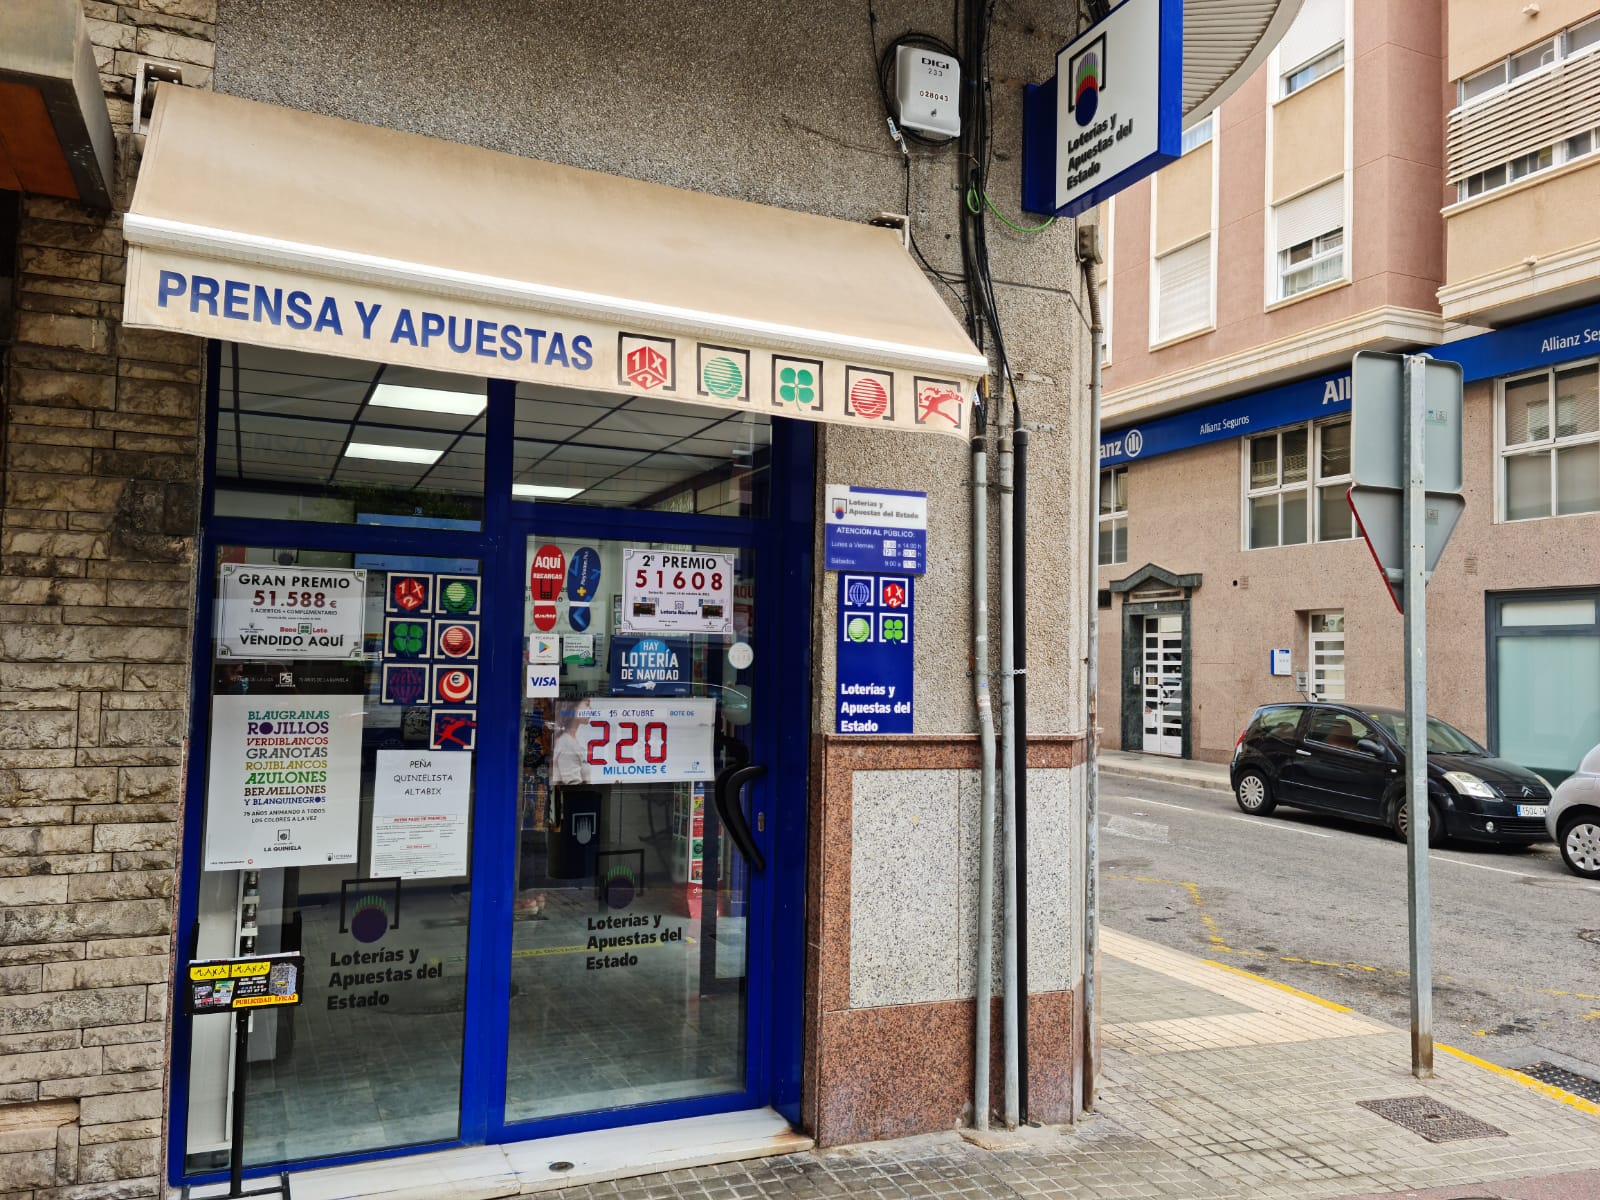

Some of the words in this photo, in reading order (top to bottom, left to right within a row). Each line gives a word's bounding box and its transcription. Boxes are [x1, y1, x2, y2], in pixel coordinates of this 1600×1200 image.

[921, 57, 950, 70] DIGI
[1067, 119, 1109, 154] Loterías
[1110, 113, 1117, 131] y
[1067, 135, 1114, 172] Apuestas
[1116, 118, 1133, 141] del
[1067, 161, 1101, 191] Estado
[158, 269, 343, 336] PRENSA
[355, 300, 382, 340] Y
[390, 308, 593, 371] APUESTAS
[1541, 334, 1581, 353] Allianz
[1322, 375, 1352, 405] All
[1200, 423, 1222, 435] Allianz
[1222, 415, 1250, 430] Seguros
[879, 502, 884, 510] y
[849, 508, 880, 517] Apuestas
[882, 510, 893, 518] del
[895, 511, 919, 519] Estado
[534, 554, 561, 569] AQUÍ
[662, 555, 717, 570] PREMIO
[239, 574, 286, 586] GRAN
[291, 576, 350, 588] PREMIO
[533, 572, 563, 580] RECARGAS
[635, 569, 723, 591] 51608
[252, 589, 326, 608] 51.588
[329, 600, 337, 608] €
[239, 634, 304, 646] VENDIDO
[308, 634, 344, 647] AQUÍ
[643, 641, 660, 652] HAY
[621, 648, 679, 668] LOTERÍA
[531, 676, 557, 687] VISA
[621, 668, 634, 680] DE
[636, 668, 679, 681] NAVIDAD
[841, 682, 886, 695] Loterías
[888, 686, 896, 698] y
[247, 710, 330, 720] BLAUGRANAS
[622, 709, 655, 717] OCTUBRE
[841, 701, 891, 716] Apuestas
[893, 701, 911, 714] del
[841, 719, 879, 732] Estado
[246, 737, 329, 746] VERDIBLANCOS
[587, 720, 668, 766] 220
[246, 747, 328, 759] GRANOTAS
[245, 760, 328, 771] ROJIBLANCOS
[409, 758, 432, 769] PEÑA
[602, 765, 657, 775] MILLONES
[659, 765, 667, 775] €
[244, 770, 327, 785] AZULONES
[393, 774, 453, 783] QUINIELISTA
[243, 785, 327, 797] BERMELLONES
[404, 787, 442, 796] ALTABIX
[243, 798, 251, 806] Y
[251, 809, 268, 817] AÑOS
[587, 913, 649, 931] Loterías
[653, 914, 662, 929] y
[586, 931, 657, 952] Apuestas
[660, 927, 682, 943] del
[330, 947, 404, 967] Loterías
[409, 948, 419, 964] y
[586, 953, 638, 970] Estado
[328, 967, 413, 990] Apuestas
[416, 962, 443, 979] del
[235, 997, 272, 1006] PUBLICIDAD
[327, 990, 390, 1010] Estado
